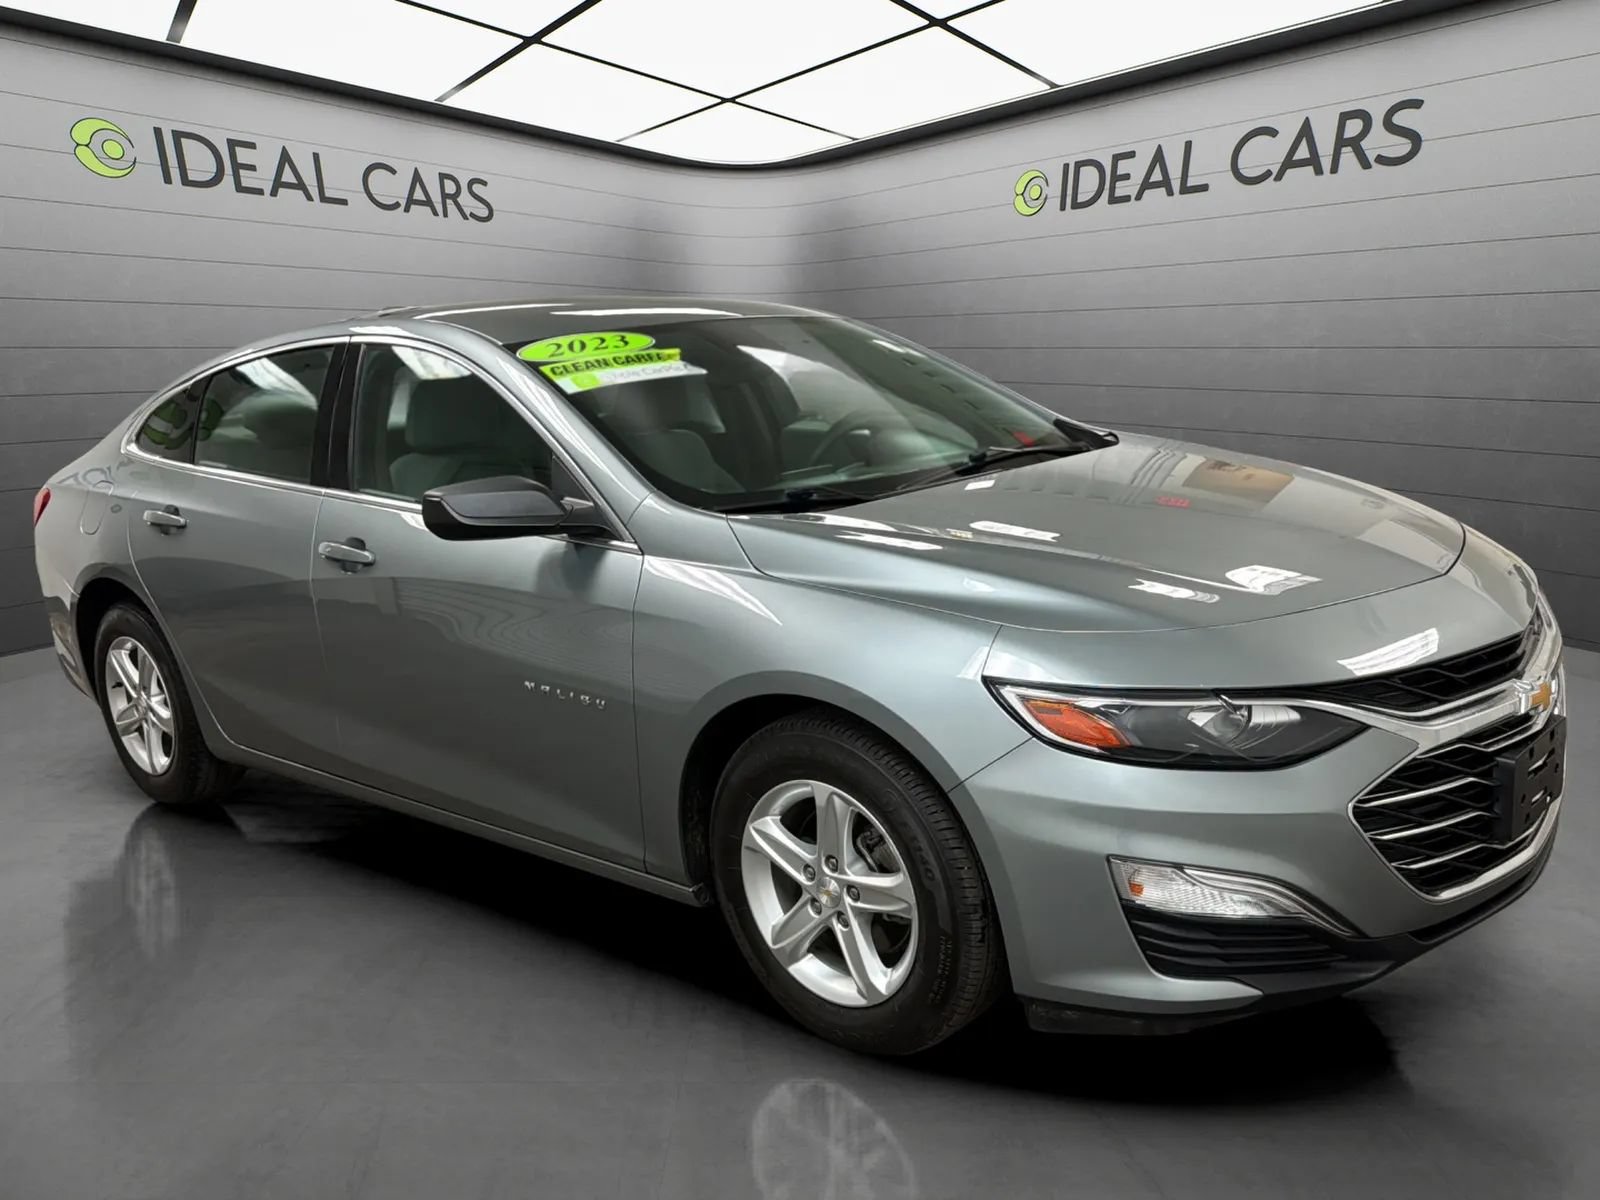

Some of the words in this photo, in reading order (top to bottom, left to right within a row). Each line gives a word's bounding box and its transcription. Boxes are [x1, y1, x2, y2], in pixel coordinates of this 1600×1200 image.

[1060, 140, 1209, 212] IDEAL
[1230, 98, 1425, 186] CARS
[153, 126, 348, 205] IDEAL
[362, 162, 494, 222] CARS
[547, 335, 630, 356] 2023
[551, 356, 610, 376] CLEAN
[524, 680, 606, 710] MALIBU
